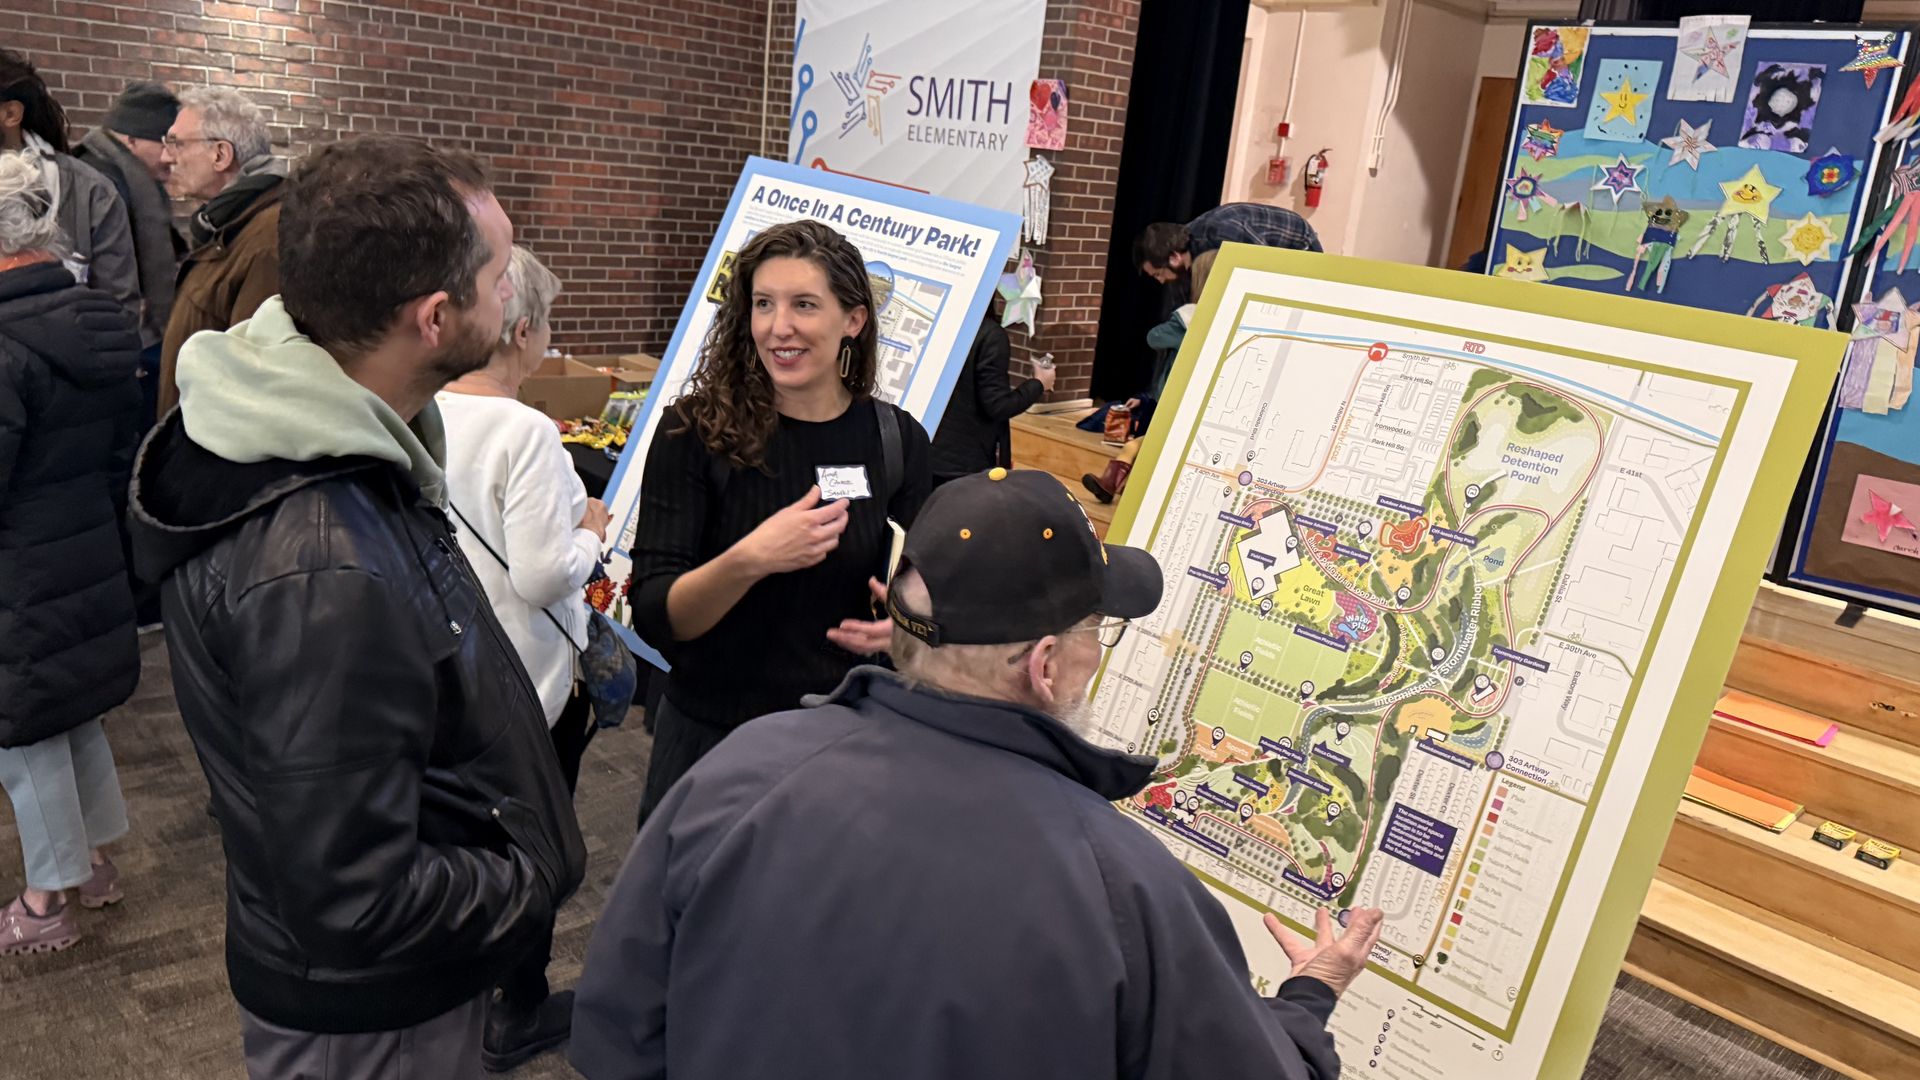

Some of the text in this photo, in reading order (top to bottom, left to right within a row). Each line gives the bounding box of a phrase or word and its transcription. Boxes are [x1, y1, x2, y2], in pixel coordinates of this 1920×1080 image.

[907, 75, 1012, 124] SMITH
[907, 124, 1008, 151] ELEMENTARY
[752, 185, 765, 203] A
[767, 188, 809, 214] Once
[811, 198, 829, 219] In
[830, 204, 845, 224] A
[847, 207, 924, 246] Century
[924, 226, 982, 258] Park!
[1462, 341, 1486, 354] RTD
[1402, 353, 1419, 362] Smith
[1400, 374, 1412, 383] Park
[1413, 376, 1424, 384] Hill
[1375, 422, 1402, 434] Ironwood
[1371, 438, 1405, 452] Park Hill Sq
[1506, 442, 1564, 463] Reshaped
[1501, 454, 1559, 476] Detention
[1510, 470, 1541, 485] Pond
[1626, 469, 1643, 478] 41st
[1267, 479, 1287, 490] Artway
[1380, 498, 1422, 514] Outdoor Adventure
[1296, 517, 1335, 532] Outdoor Adventure
[1431, 528, 1475, 545] Off-leash Dog Park
[1483, 555, 1505, 567] Pond
[1307, 537, 1318, 555] Bike
[1321, 558, 1352, 590] Pedestrian
[1353, 584, 1371, 598] Loop
[1369, 595, 1388, 606] Path
[1303, 585, 1325, 597] Great
[1555, 573, 1570, 603] Dahlia St
[1300, 594, 1321, 606] Lawn
[1345, 614, 1371, 625] Water
[1352, 621, 1371, 633] Play
[1374, 678, 1438, 707] Intermittent
[1470, 579, 1482, 617] Ribbon
[1565, 643, 1583, 655] 39th
[1583, 650, 1597, 659] Ave
[1493, 647, 1546, 670] Community Gardens
[1561, 670, 1581, 711] Eudora Way
[1505, 763, 1547, 784] Connection
[1508, 756, 1550, 777] 303 Artway
[1501, 778, 1526, 792] Legend
[1398, 807, 1434, 827] The memorial
[1393, 820, 1411, 831] design
[1395, 814, 1417, 826] location
[1428, 828, 1444, 839] space
[1384, 843, 1394, 851] the
[1386, 837, 1402, 848] loved
[1391, 826, 1444, 852] determined with the
[1412, 842, 1434, 855] families
[1433, 852, 1445, 860] and
